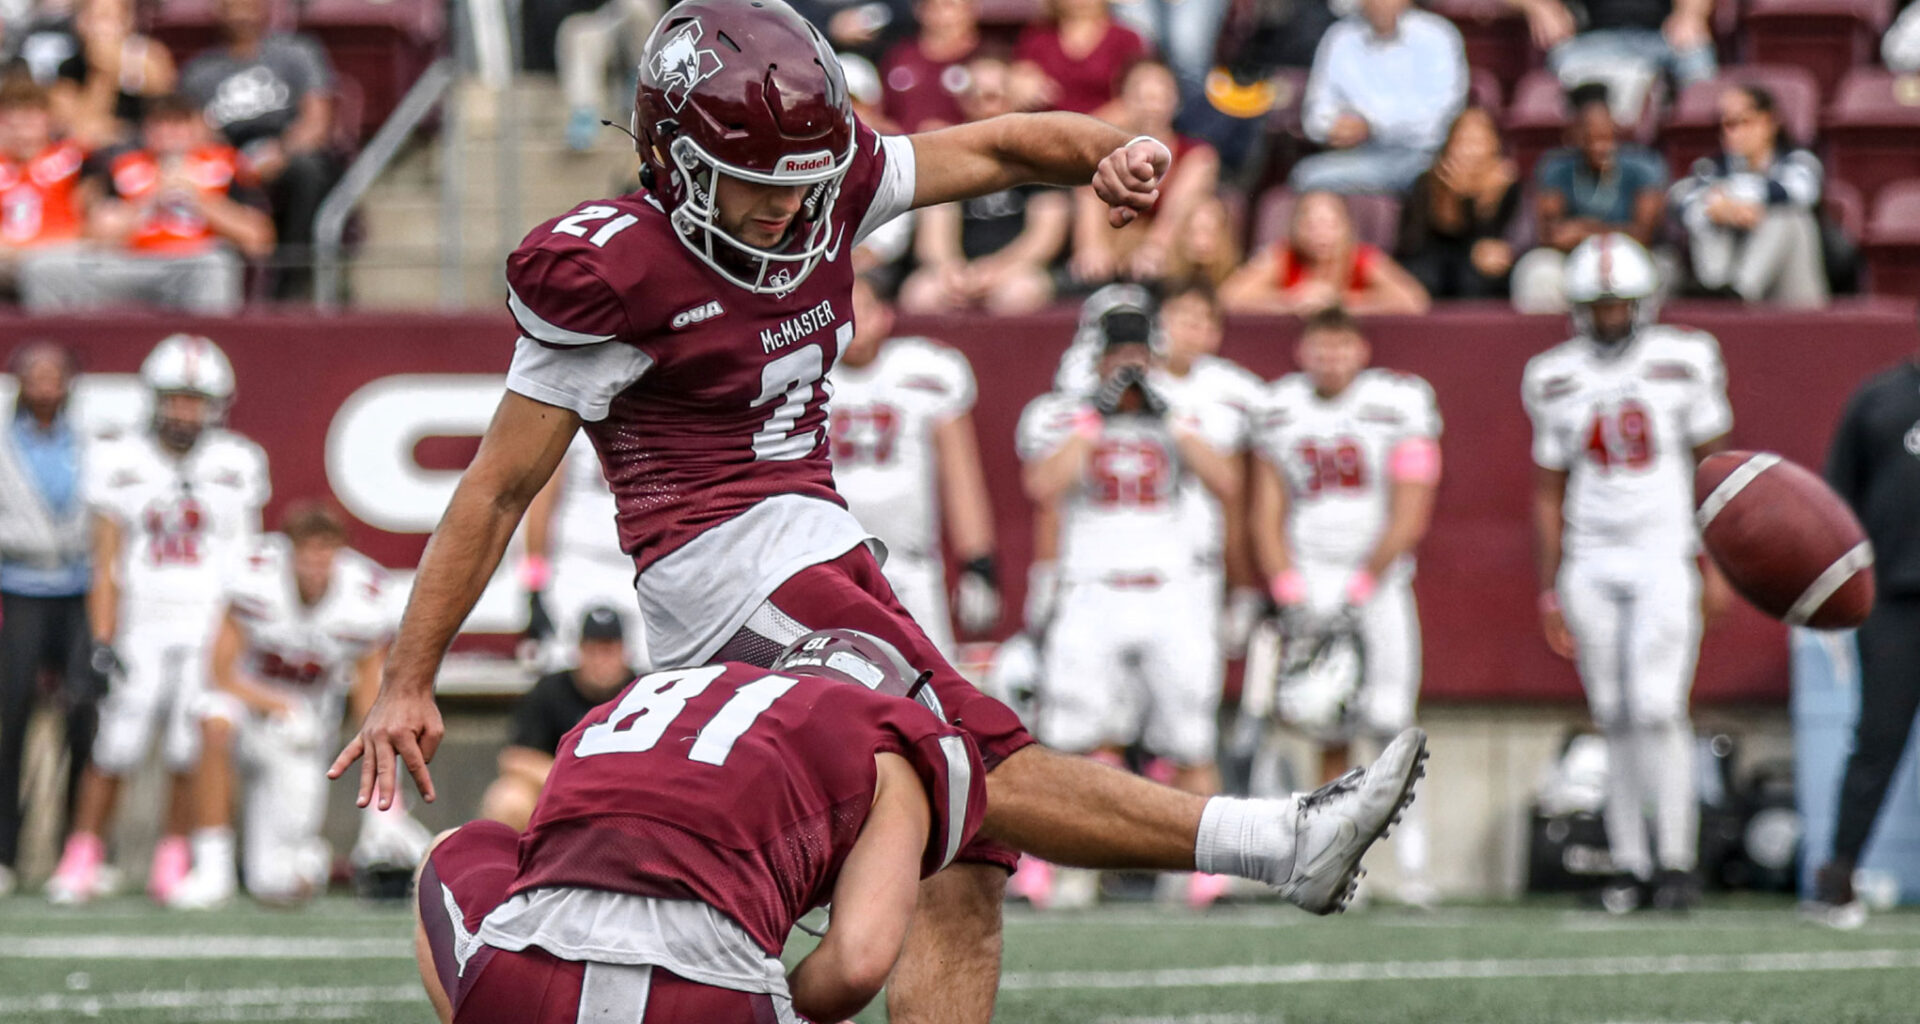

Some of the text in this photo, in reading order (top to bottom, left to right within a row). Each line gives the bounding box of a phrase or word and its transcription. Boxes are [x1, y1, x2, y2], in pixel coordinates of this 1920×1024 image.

[786, 155, 831, 171] Riddell
[804, 180, 828, 209] Ridd
[551, 205, 639, 248] 21
[760, 300, 836, 354] McMASTER
[1582, 401, 1656, 474] 49
[802, 636, 832, 651] 81
[574, 664, 800, 767] 81
